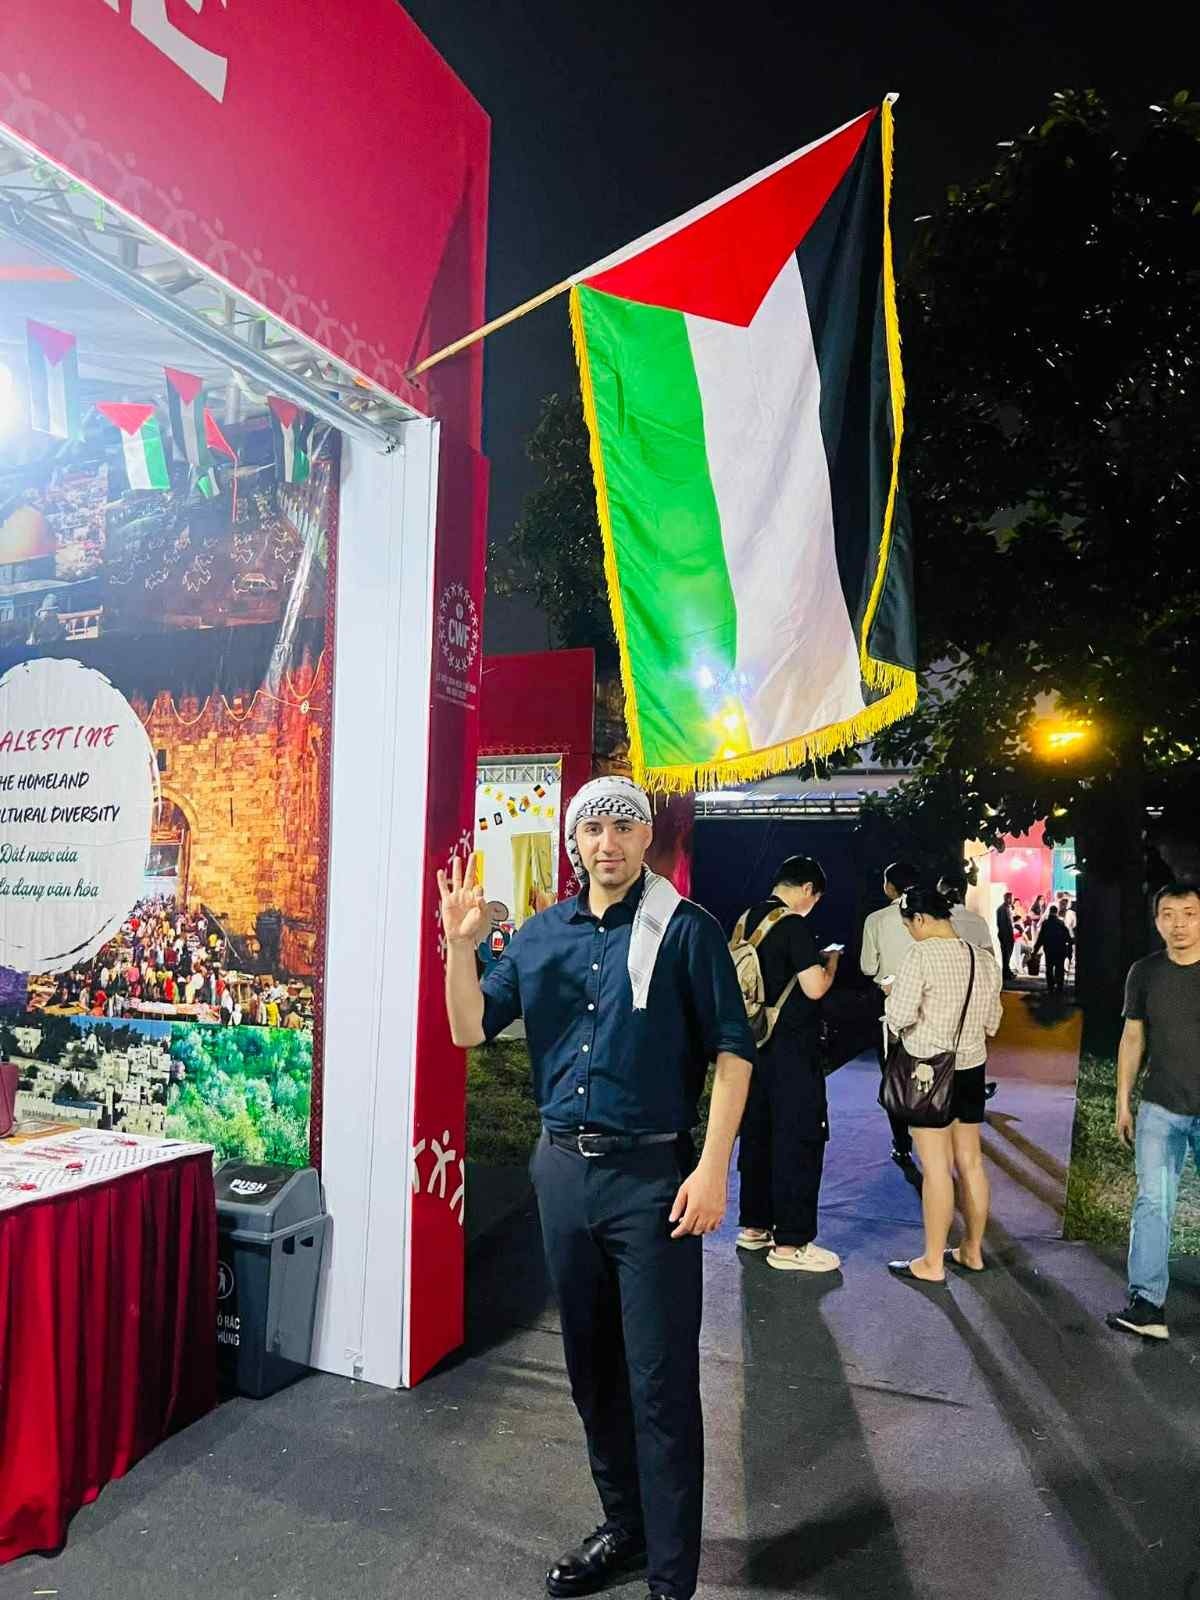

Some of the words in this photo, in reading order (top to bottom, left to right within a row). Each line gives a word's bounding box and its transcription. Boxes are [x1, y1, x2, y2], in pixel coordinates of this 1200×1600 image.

[448, 618, 471, 649] CWF
[0, 725, 119, 752] ALESTINE
[17, 771, 90, 791] HOMELAND
[0, 806, 48, 823] LTURAL
[50, 804, 120, 823] DIVERSITY
[230, 1179, 267, 1192] PUSH
